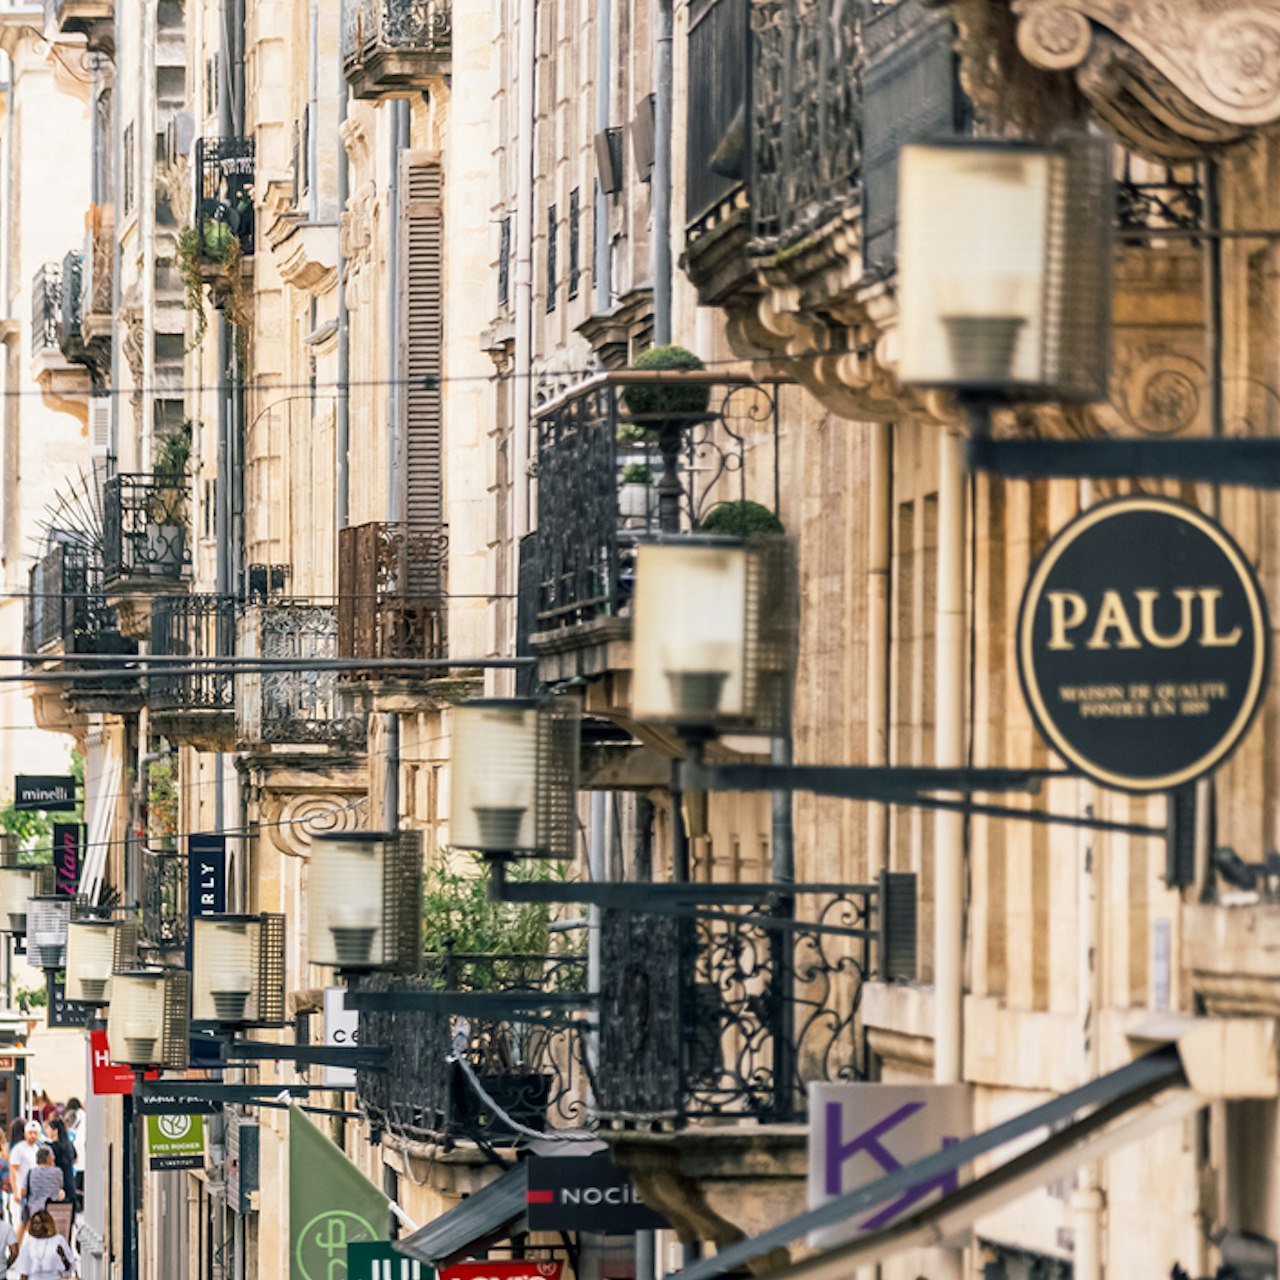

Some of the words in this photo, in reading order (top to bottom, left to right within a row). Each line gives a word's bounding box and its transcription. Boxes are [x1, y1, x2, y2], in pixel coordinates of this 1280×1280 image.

[1046, 588, 1243, 650] PAUL
[21, 786, 68, 801] minelli
[151, 1143, 170, 1151] YVES
[170, 1142, 200, 1150] ROCHER
